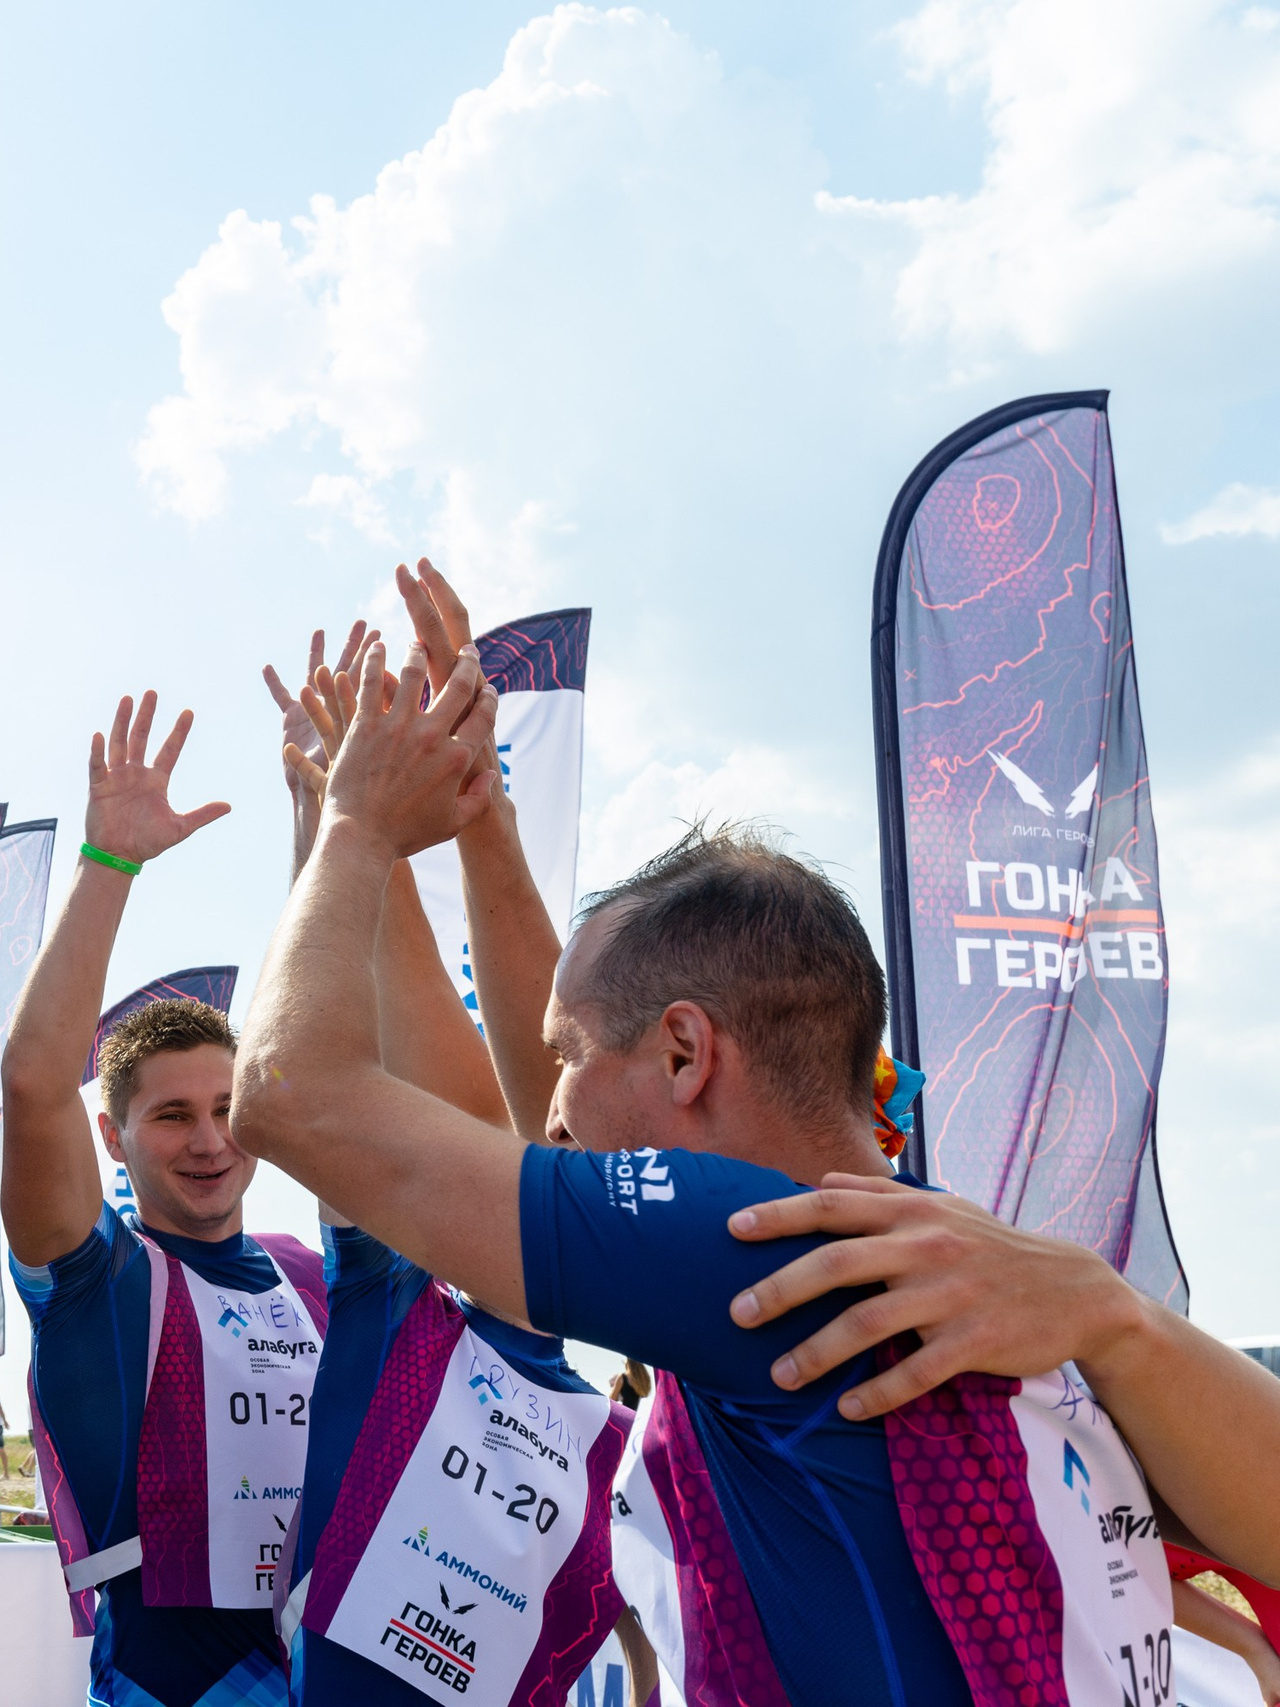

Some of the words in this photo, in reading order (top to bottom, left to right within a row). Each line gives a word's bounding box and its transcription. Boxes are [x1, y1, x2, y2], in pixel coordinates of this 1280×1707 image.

[1012, 825, 1052, 838] ЛИГА
[956, 931, 1164, 992] ГЕРОЕВ
[248, 1339, 318, 1359] алабуга
[230, 1392, 312, 1425] 01-2
[490, 1409, 569, 1472] алабуга
[262, 1487, 302, 1499] АММО
[441, 1445, 560, 1535] 01-20
[435, 1551, 528, 1614] АММОНИЙ
[380, 1626, 471, 1694] ГЕРОЕВ
[400, 1602, 477, 1662] ГОНКА
[1104, 1628, 1170, 1707] 1-20
